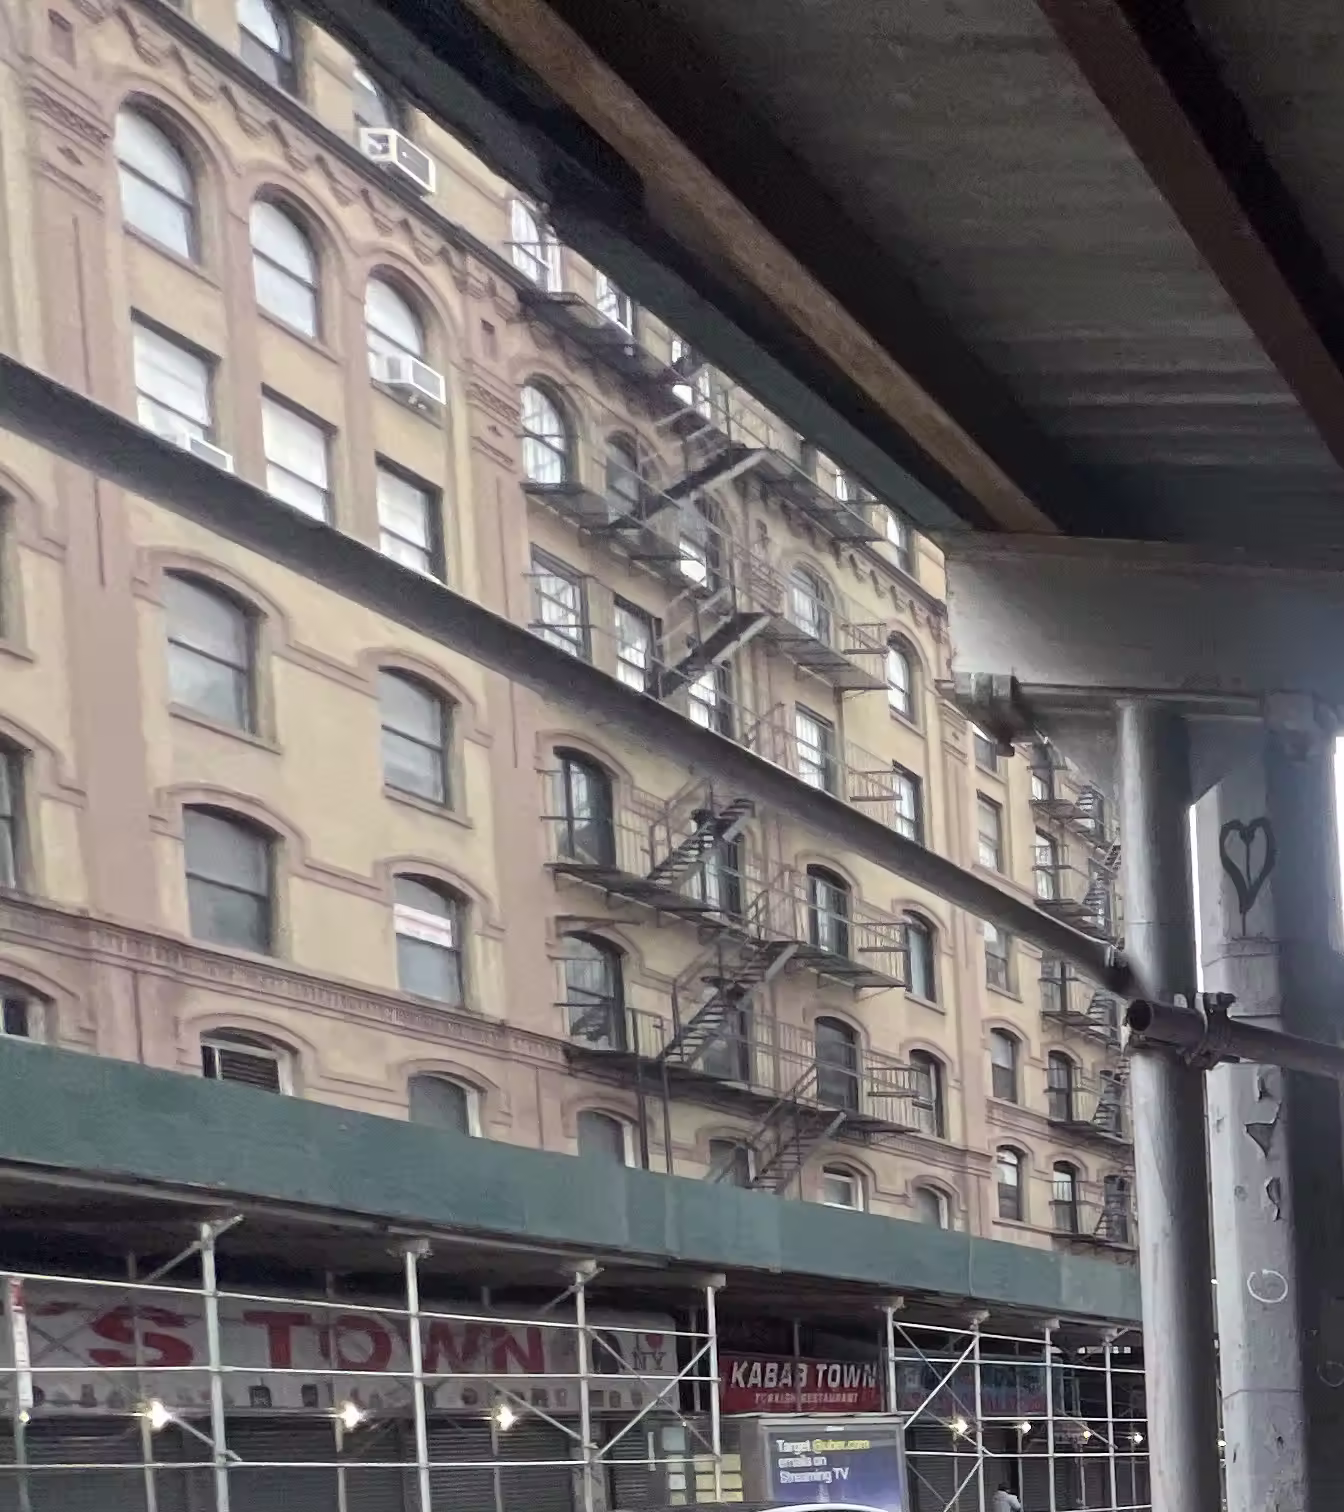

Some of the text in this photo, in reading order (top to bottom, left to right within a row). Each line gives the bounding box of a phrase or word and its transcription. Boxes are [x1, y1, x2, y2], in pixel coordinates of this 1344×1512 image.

[242, 1310, 545, 1374] TOWN
[731, 1361, 809, 1389] KABAB
[815, 1363, 878, 1389] TOWN
[780, 1466, 850, 1484] Streaming TV
